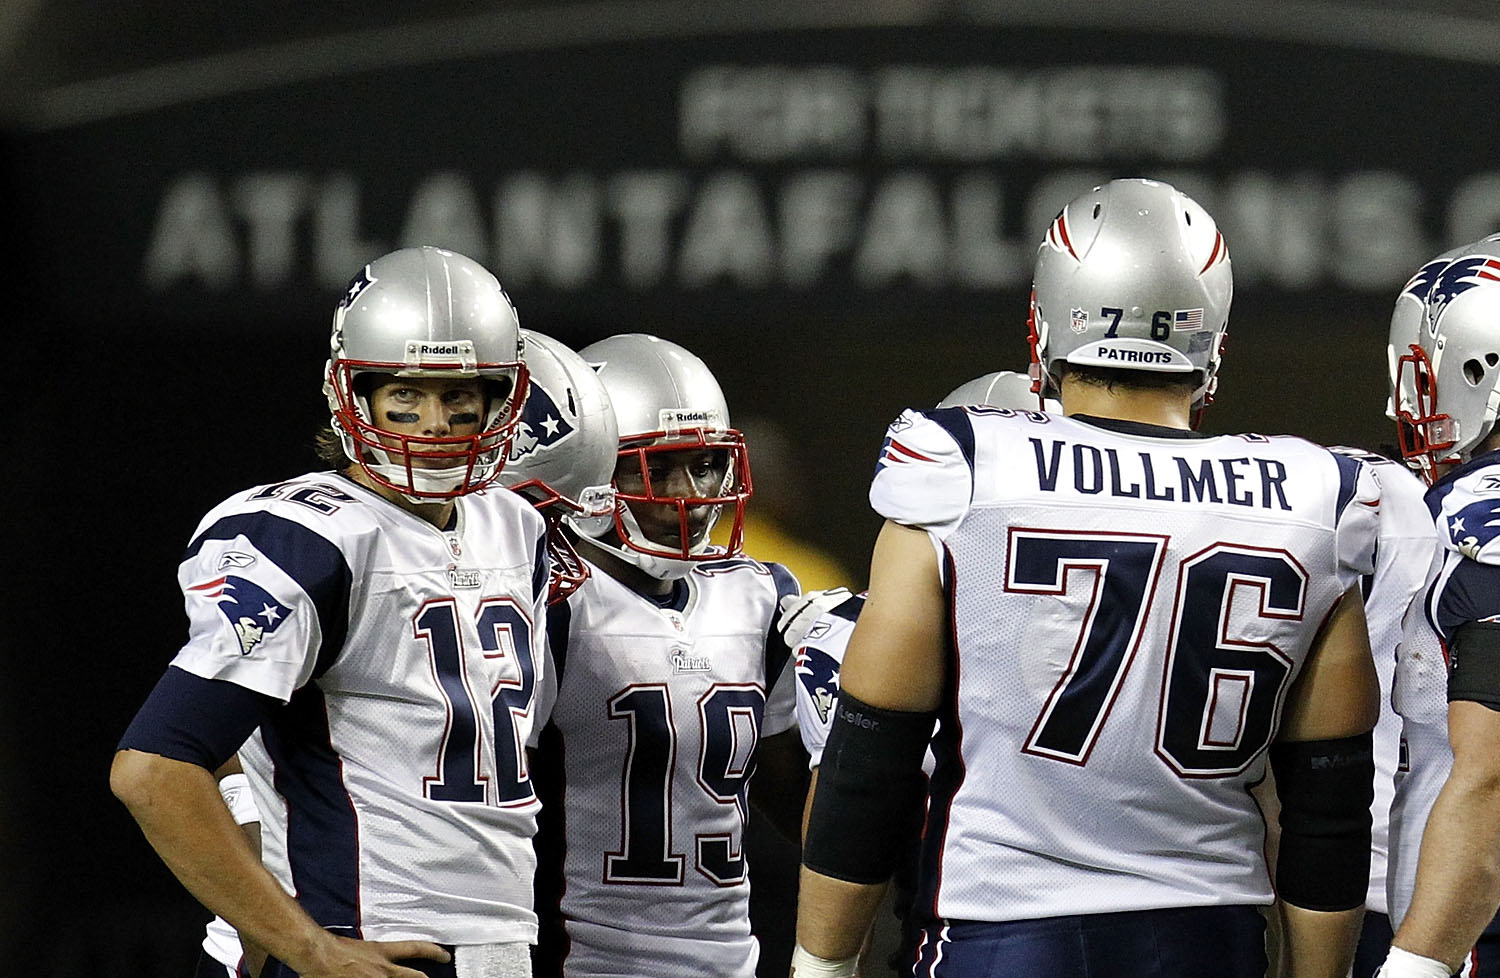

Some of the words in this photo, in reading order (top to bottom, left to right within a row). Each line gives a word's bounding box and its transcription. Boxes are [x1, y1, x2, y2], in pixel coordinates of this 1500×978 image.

[875, 64, 1224, 160] TICKETS
[421, 345, 458, 355] Riddell
[1098, 347, 1172, 363] PATRIOTS
[677, 413, 708, 422] Riddell
[1028, 437, 1292, 511] VOLLMER
[1003, 526, 1310, 780] 76
[413, 597, 542, 808] 12
[602, 683, 767, 887] 19
